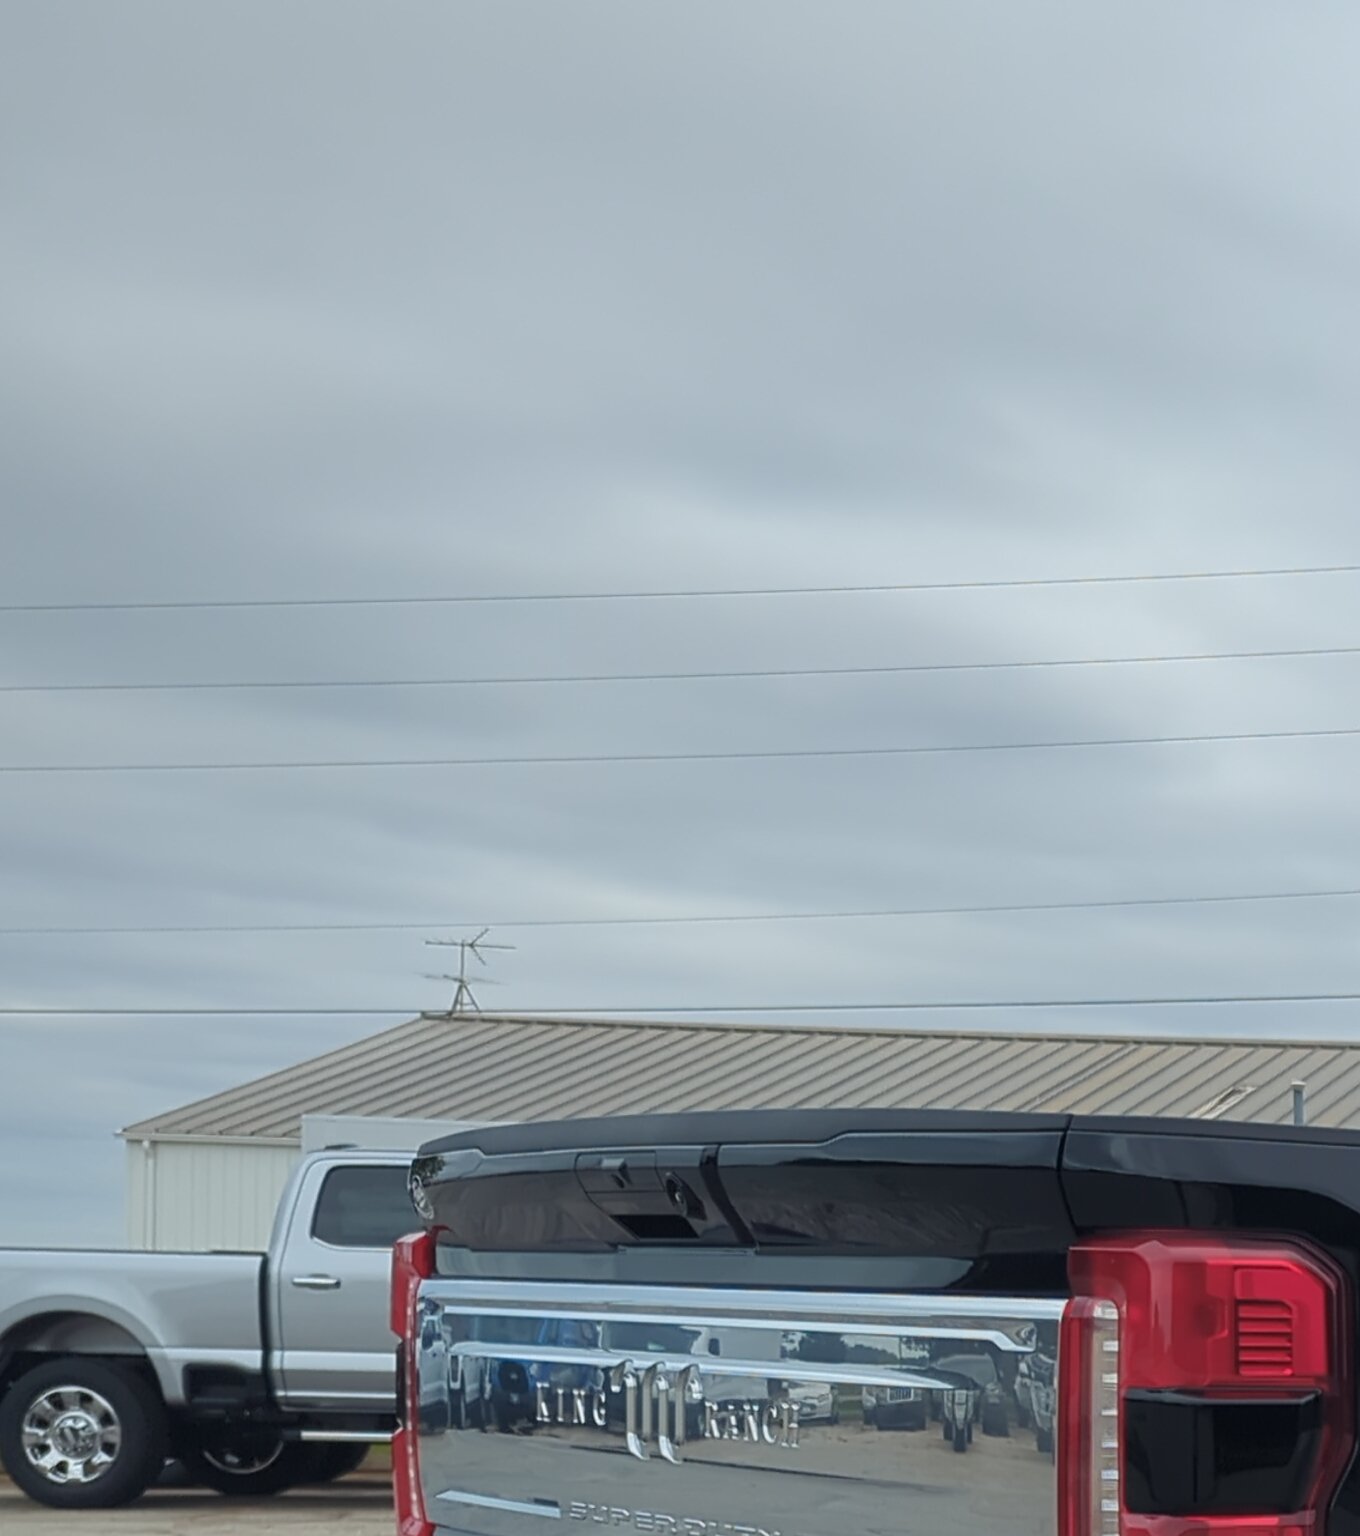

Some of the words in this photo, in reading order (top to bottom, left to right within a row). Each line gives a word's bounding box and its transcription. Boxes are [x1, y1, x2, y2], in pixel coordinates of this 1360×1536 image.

[535, 1382, 607, 1426] KING
[704, 1400, 800, 1448] RANCH
[569, 1501, 678, 1534] SUPER
